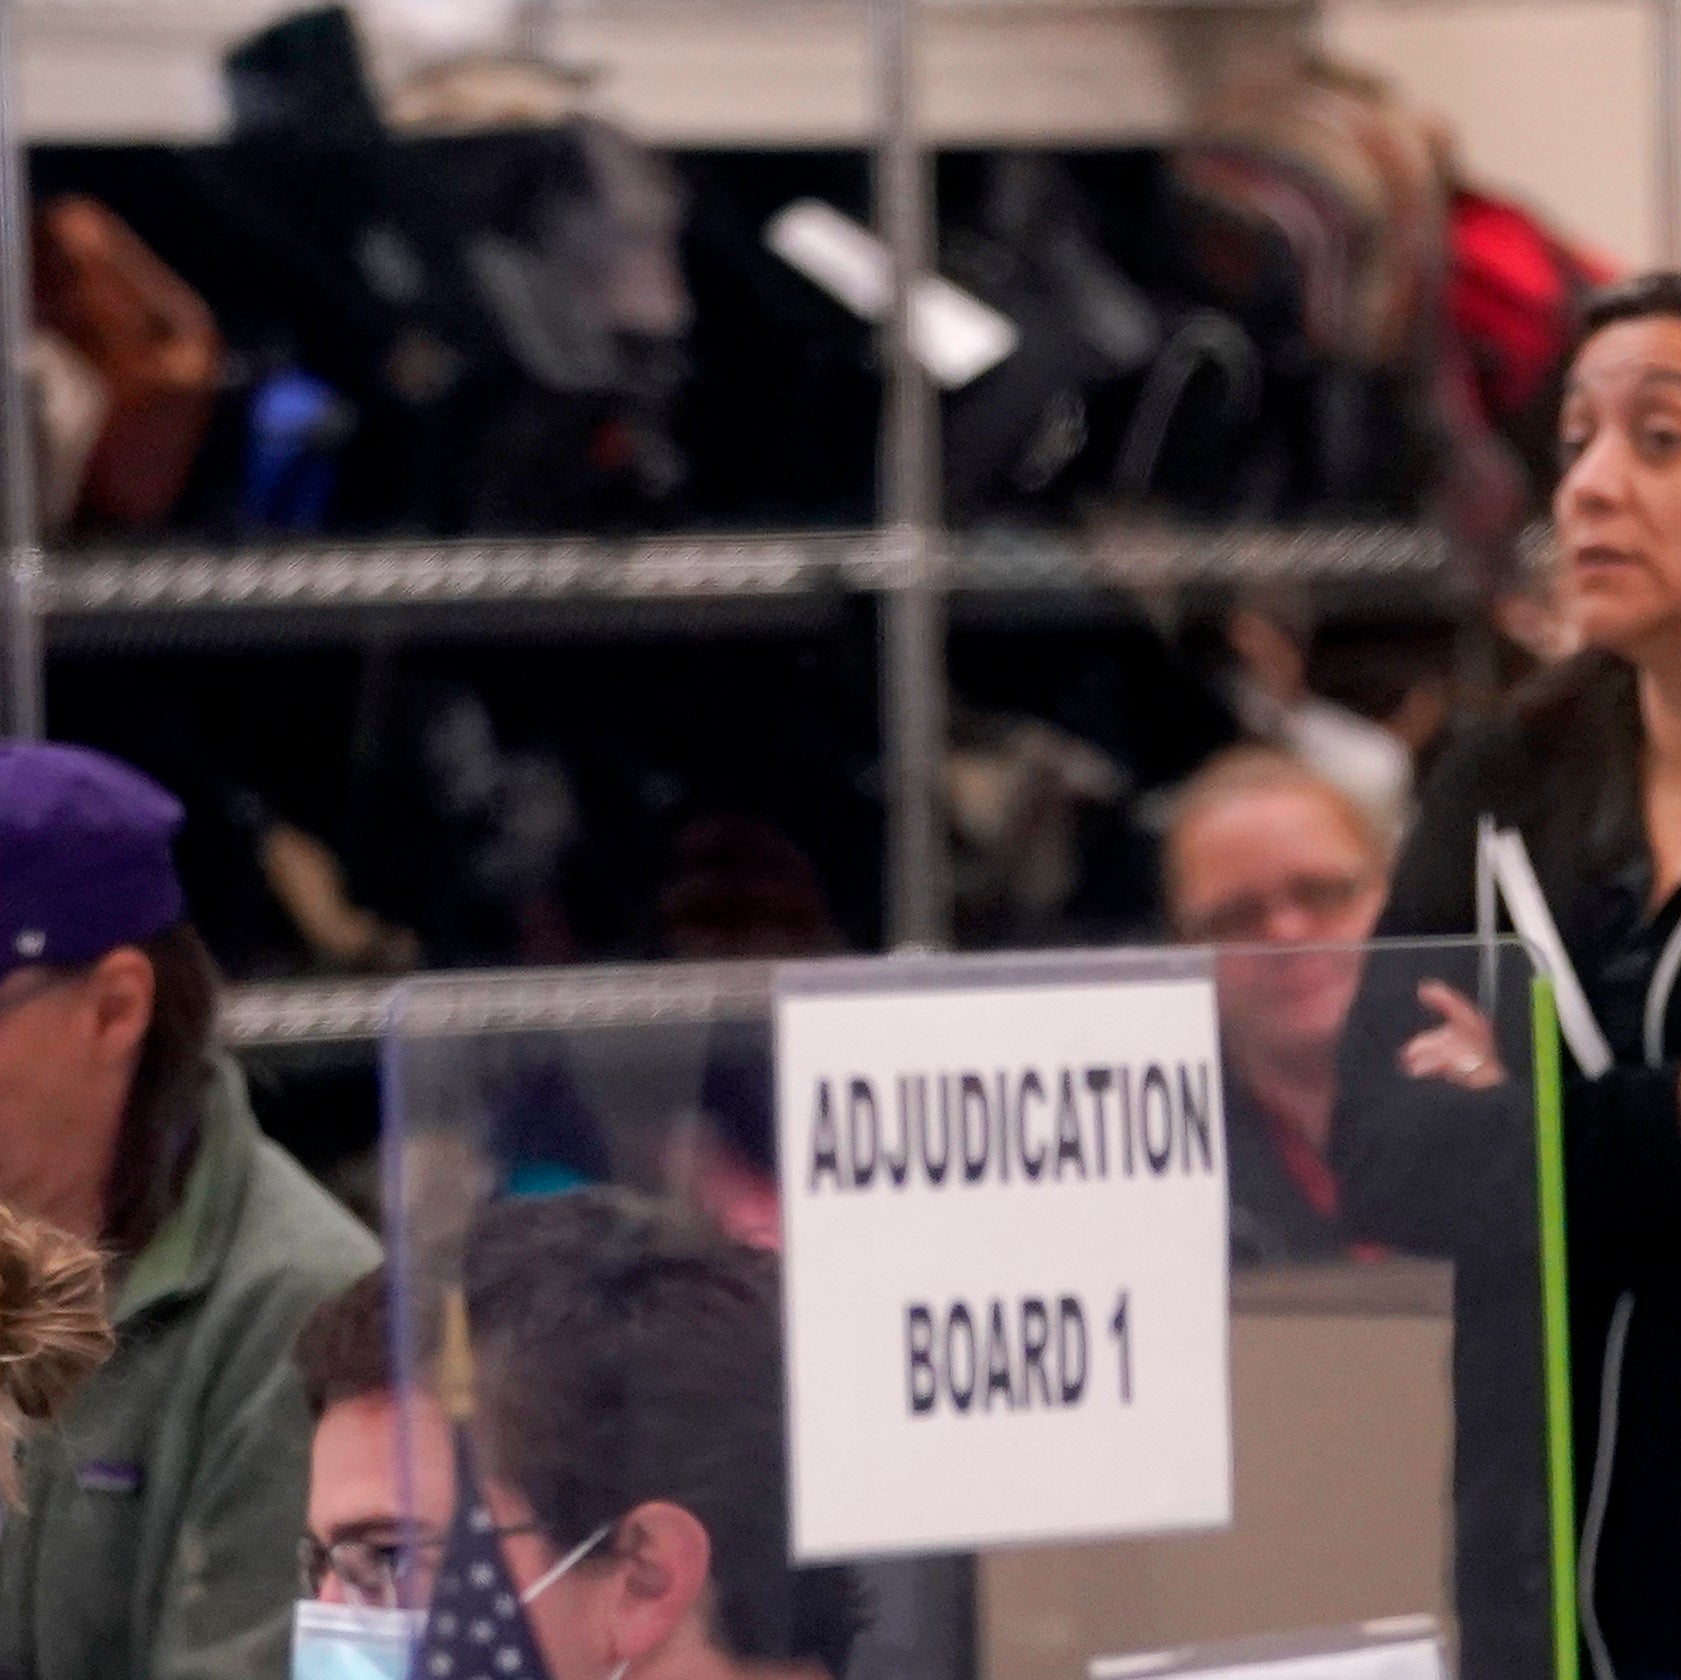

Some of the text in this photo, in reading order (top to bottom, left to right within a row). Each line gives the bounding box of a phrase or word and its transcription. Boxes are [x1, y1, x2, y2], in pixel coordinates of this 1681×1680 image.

[809, 1061, 1215, 1192] ADJUDICATION
[904, 1288, 1134, 1418] BOARD 1
